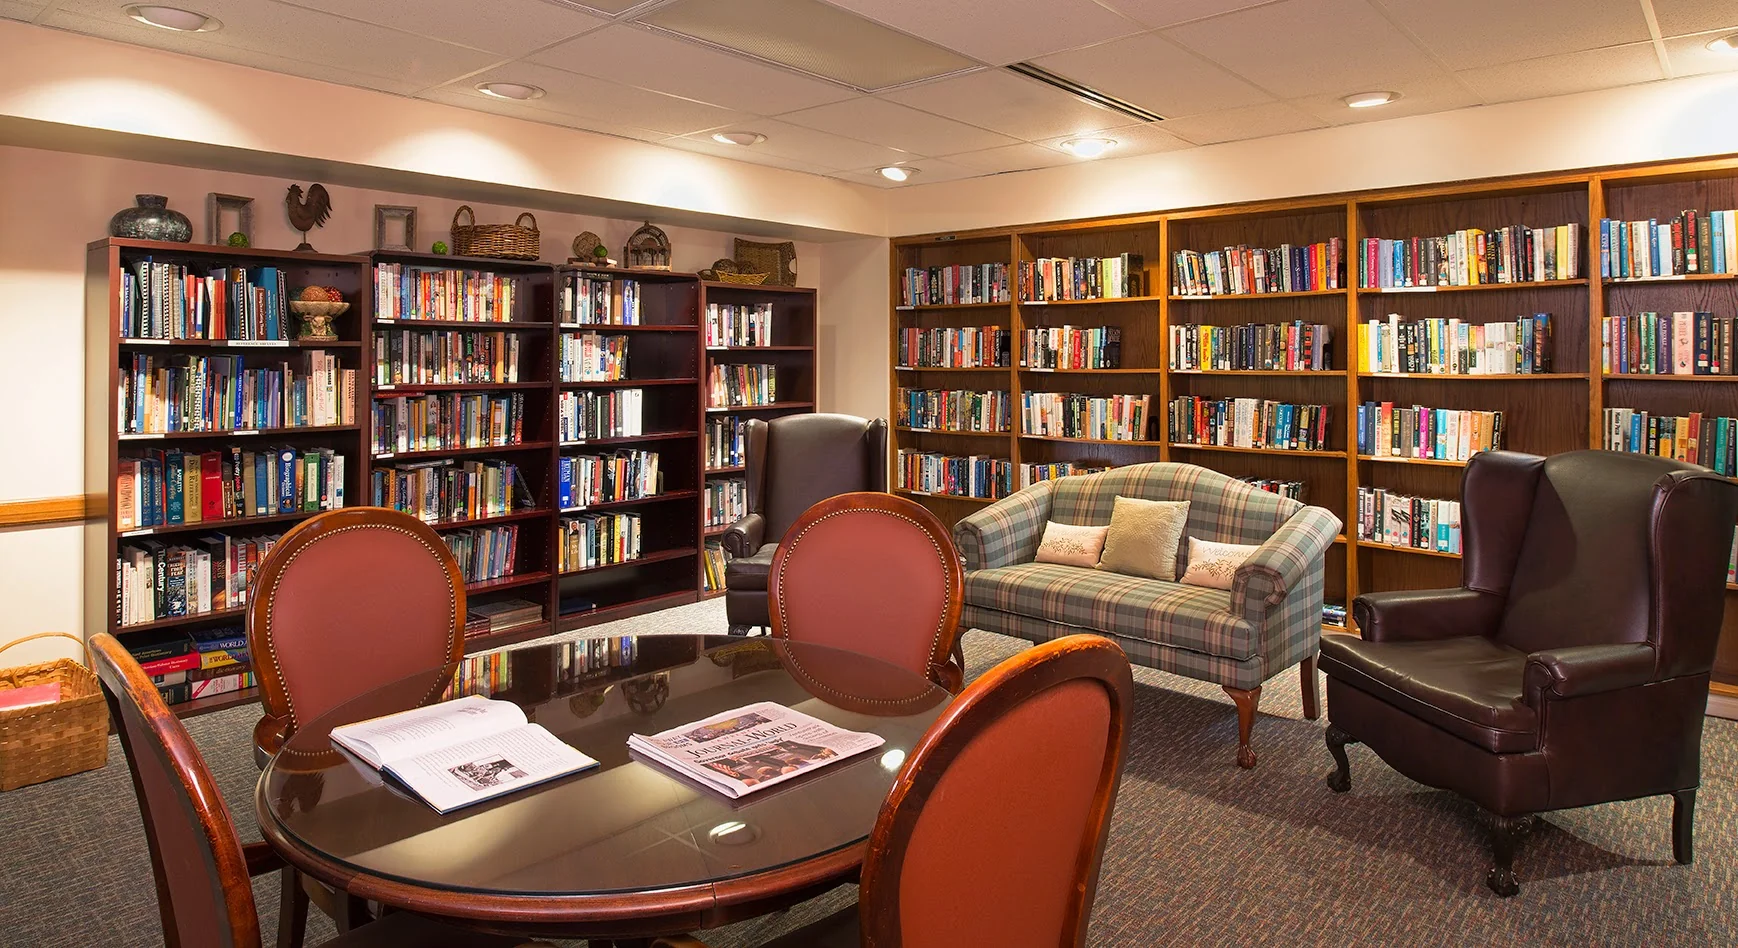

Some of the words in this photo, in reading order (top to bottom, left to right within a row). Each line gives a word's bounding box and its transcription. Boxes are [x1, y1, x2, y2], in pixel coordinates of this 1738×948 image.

[283, 462, 292, 497] Biographical
[158, 548, 166, 563] The
[156, 561, 166, 592] Century
[219, 640, 244, 649] WORLD
[686, 722, 798, 759] JOURNAL-WORLD
